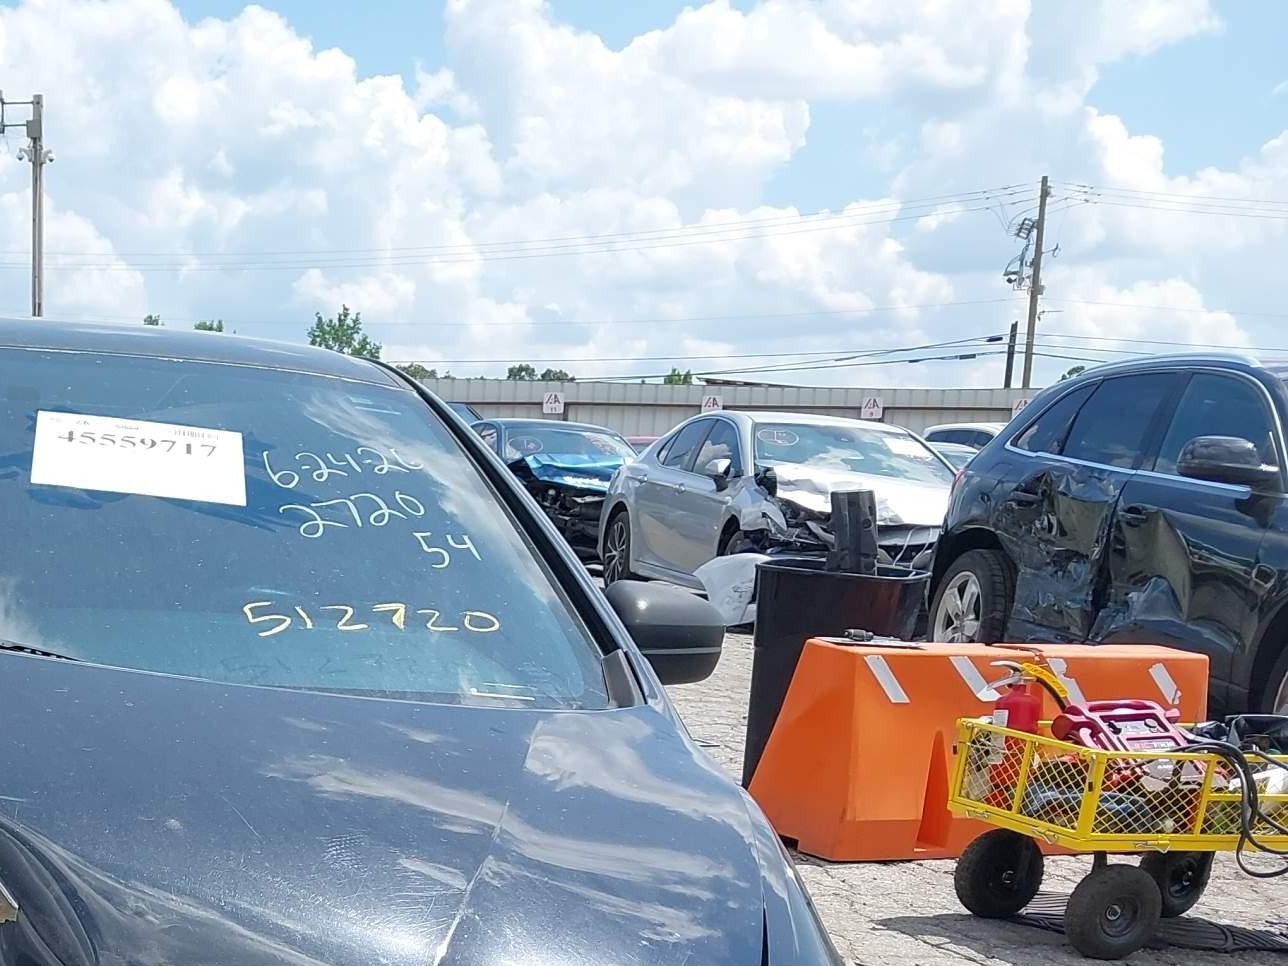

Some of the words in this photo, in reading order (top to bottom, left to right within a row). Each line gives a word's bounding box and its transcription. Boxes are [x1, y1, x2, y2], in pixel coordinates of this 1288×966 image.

[58, 430, 217, 457] 45559717
[279, 490, 425, 538] 2720
[413, 532, 482, 569] 54
[242, 601, 501, 637] 512720
